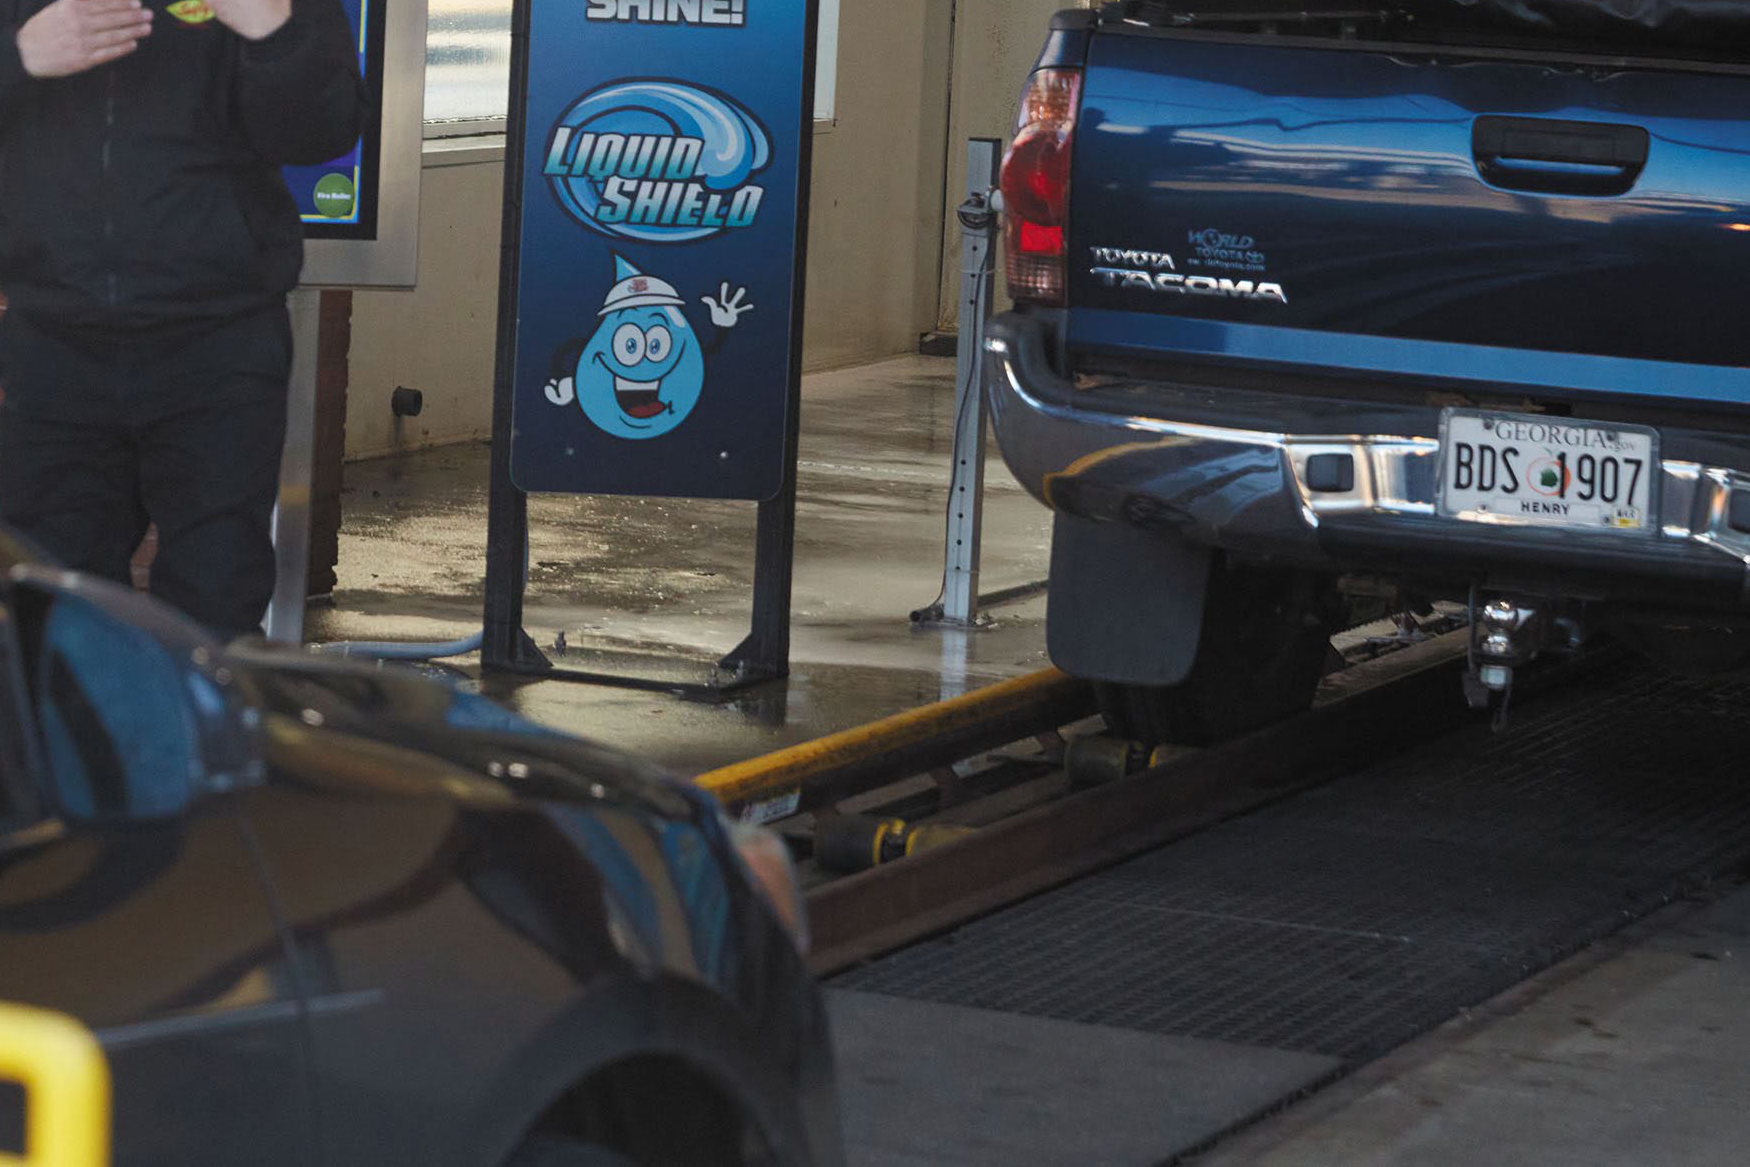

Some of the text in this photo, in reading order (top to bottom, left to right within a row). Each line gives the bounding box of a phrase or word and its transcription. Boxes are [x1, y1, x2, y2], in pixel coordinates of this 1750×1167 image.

[543, 126, 706, 181] LIQUID
[595, 175, 765, 228] SHIELD
[1090, 246, 1175, 270] TOYOTA
[1090, 267, 1288, 304] TACOMA
[1454, 442, 1642, 506] BDS 1907
[1521, 501, 1570, 515] HENRY
